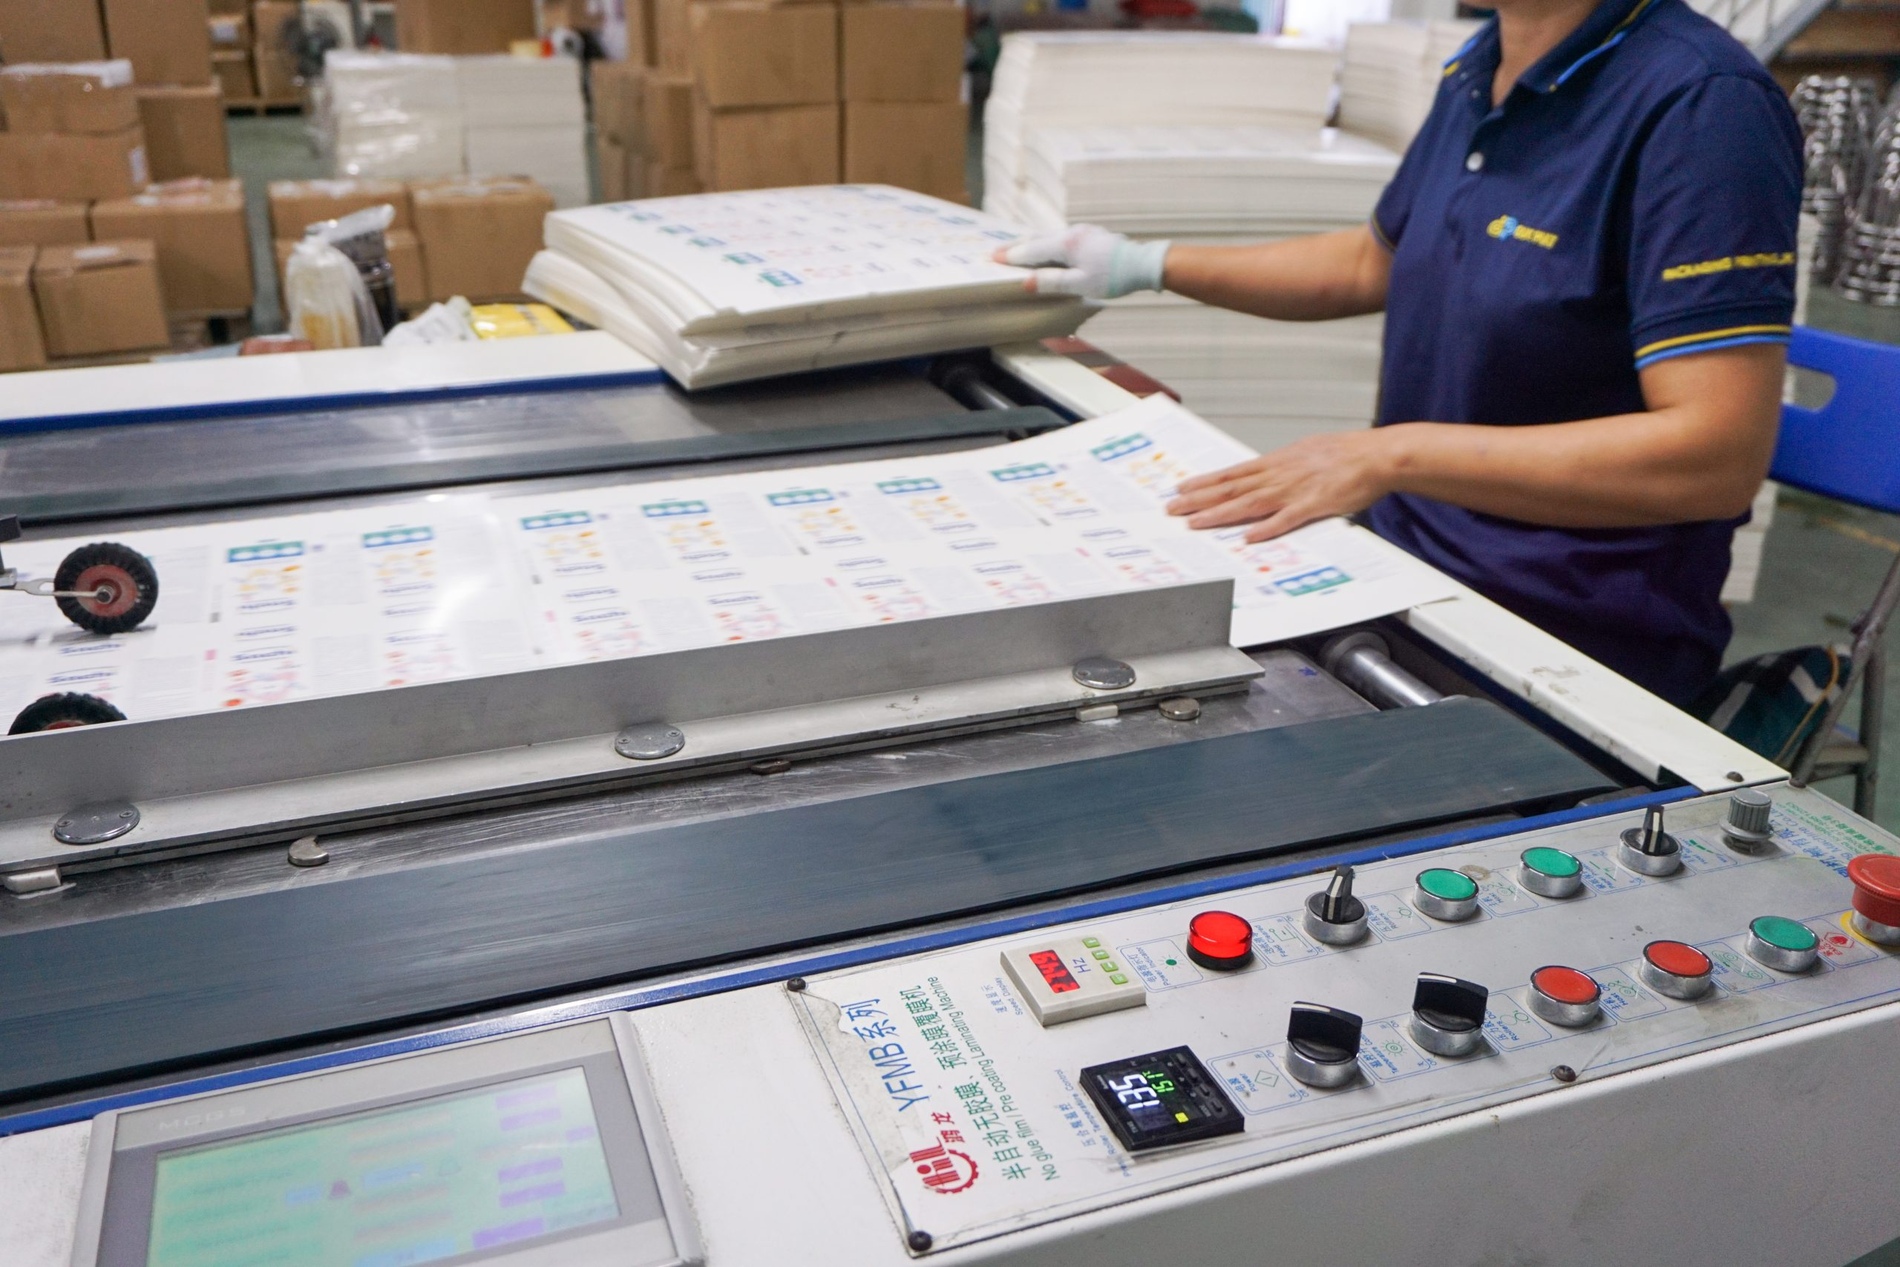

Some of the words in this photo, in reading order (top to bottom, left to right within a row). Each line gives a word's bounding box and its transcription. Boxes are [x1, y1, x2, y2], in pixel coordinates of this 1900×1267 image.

[1136, 947, 1156, 968] Indicator
[1274, 944, 1288, 957] Feed
[1072, 957, 1091, 973] Hz
[995, 977, 1010, 996] Display
[1155, 970, 1170, 986] Power
[928, 977, 954, 1011] Machine
[1611, 993, 1628, 1005] Host
[1008, 998, 1023, 1015] Speed
[949, 1011, 985, 1058] Laminating
[1497, 1021, 1519, 1040] Rollers
[1372, 1047, 1397, 1073] Temperature
[978, 1059, 1006, 1092] coating
[1055, 1069, 1074, 1091] Control
[1146, 1072, 1175, 1093] 151
[1240, 1074, 1258, 1092] Power
[1109, 1073, 1159, 1109] 135
[1000, 1095, 1017, 1112] Pre
[1073, 1093, 1100, 1132] Temperature
[1015, 1120, 1033, 1138] film
[1027, 1140, 1052, 1161] glue
[1100, 1135, 1116, 1155] Roller
[1040, 1163, 1061, 1182] No
